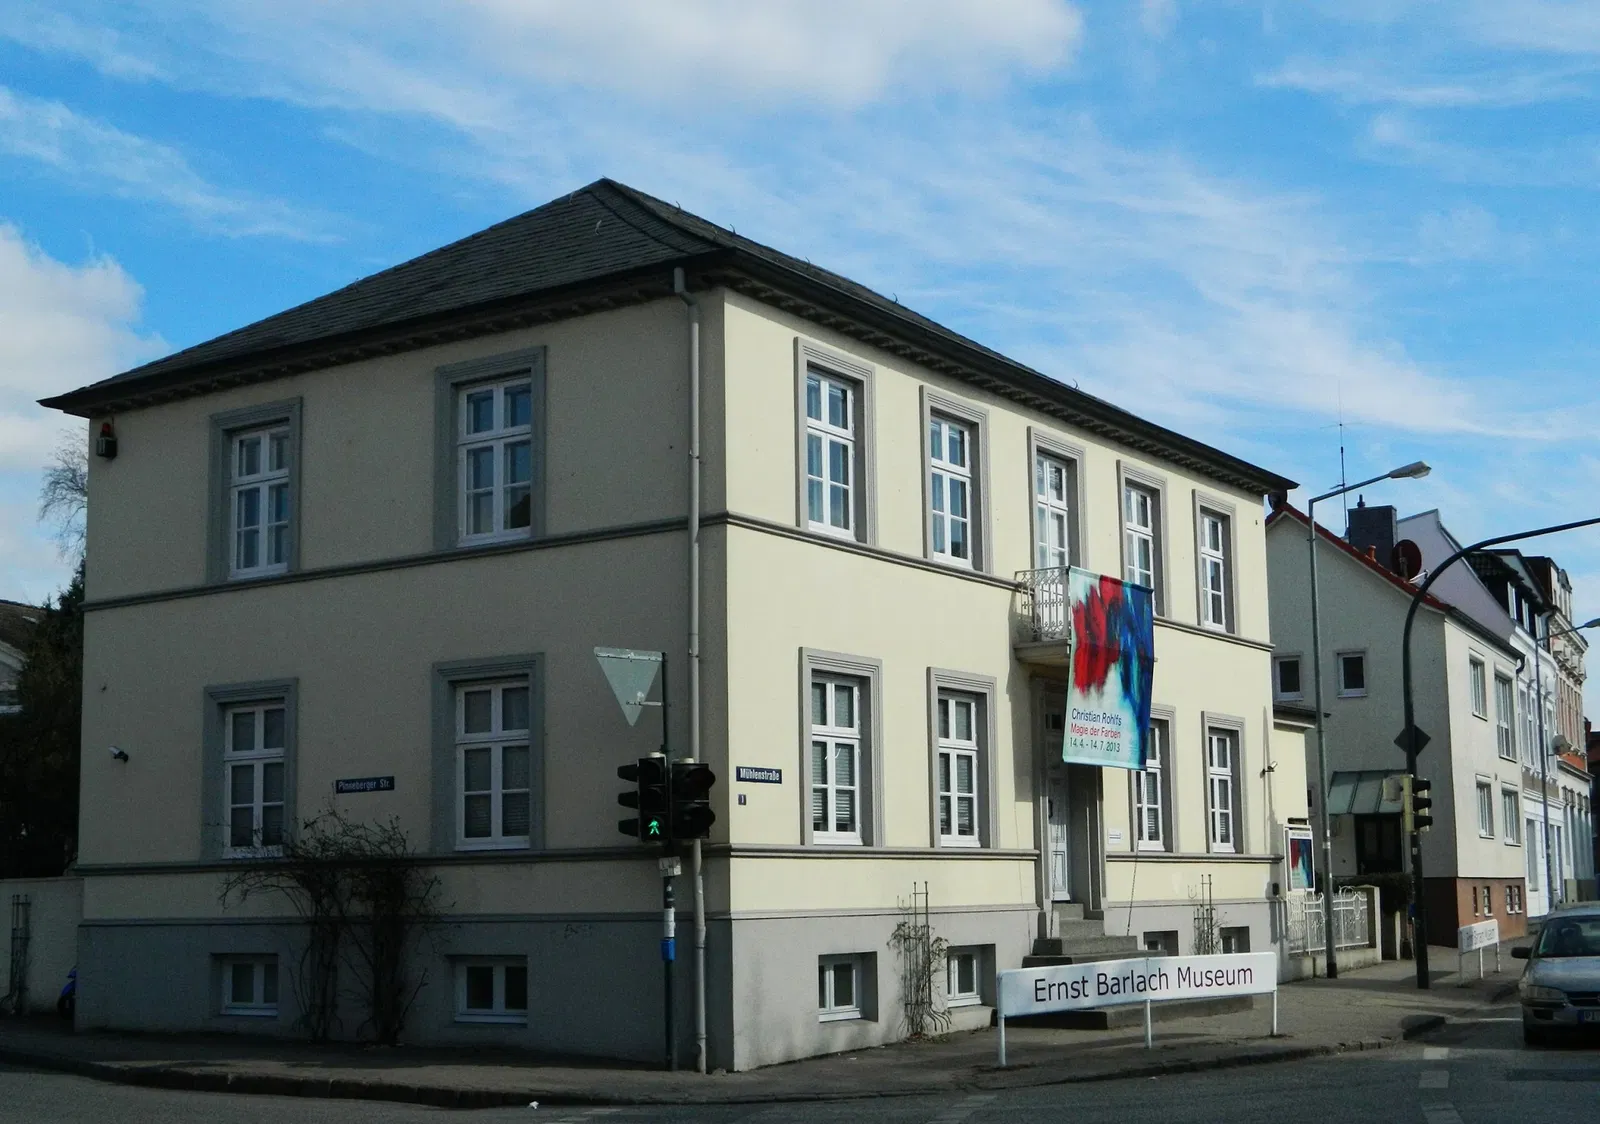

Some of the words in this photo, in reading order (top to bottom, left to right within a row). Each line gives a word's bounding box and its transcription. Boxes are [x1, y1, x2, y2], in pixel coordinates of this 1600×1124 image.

[1072, 708, 1101, 722] Christian
[1102, 712, 1121, 726] Rohlfs
[1071, 723, 1088, 737] Magie
[1090, 726, 1100, 736] der
[1101, 727, 1121, 739] Farben
[740, 768, 779, 780] Mühlenstraße
[338, 780, 376, 792] Pinneberger
[379, 778, 391, 788] Str.
[1034, 975, 1090, 1003] Ernst
[1096, 967, 1170, 996] Barlach
[1177, 966, 1253, 989] Museum
